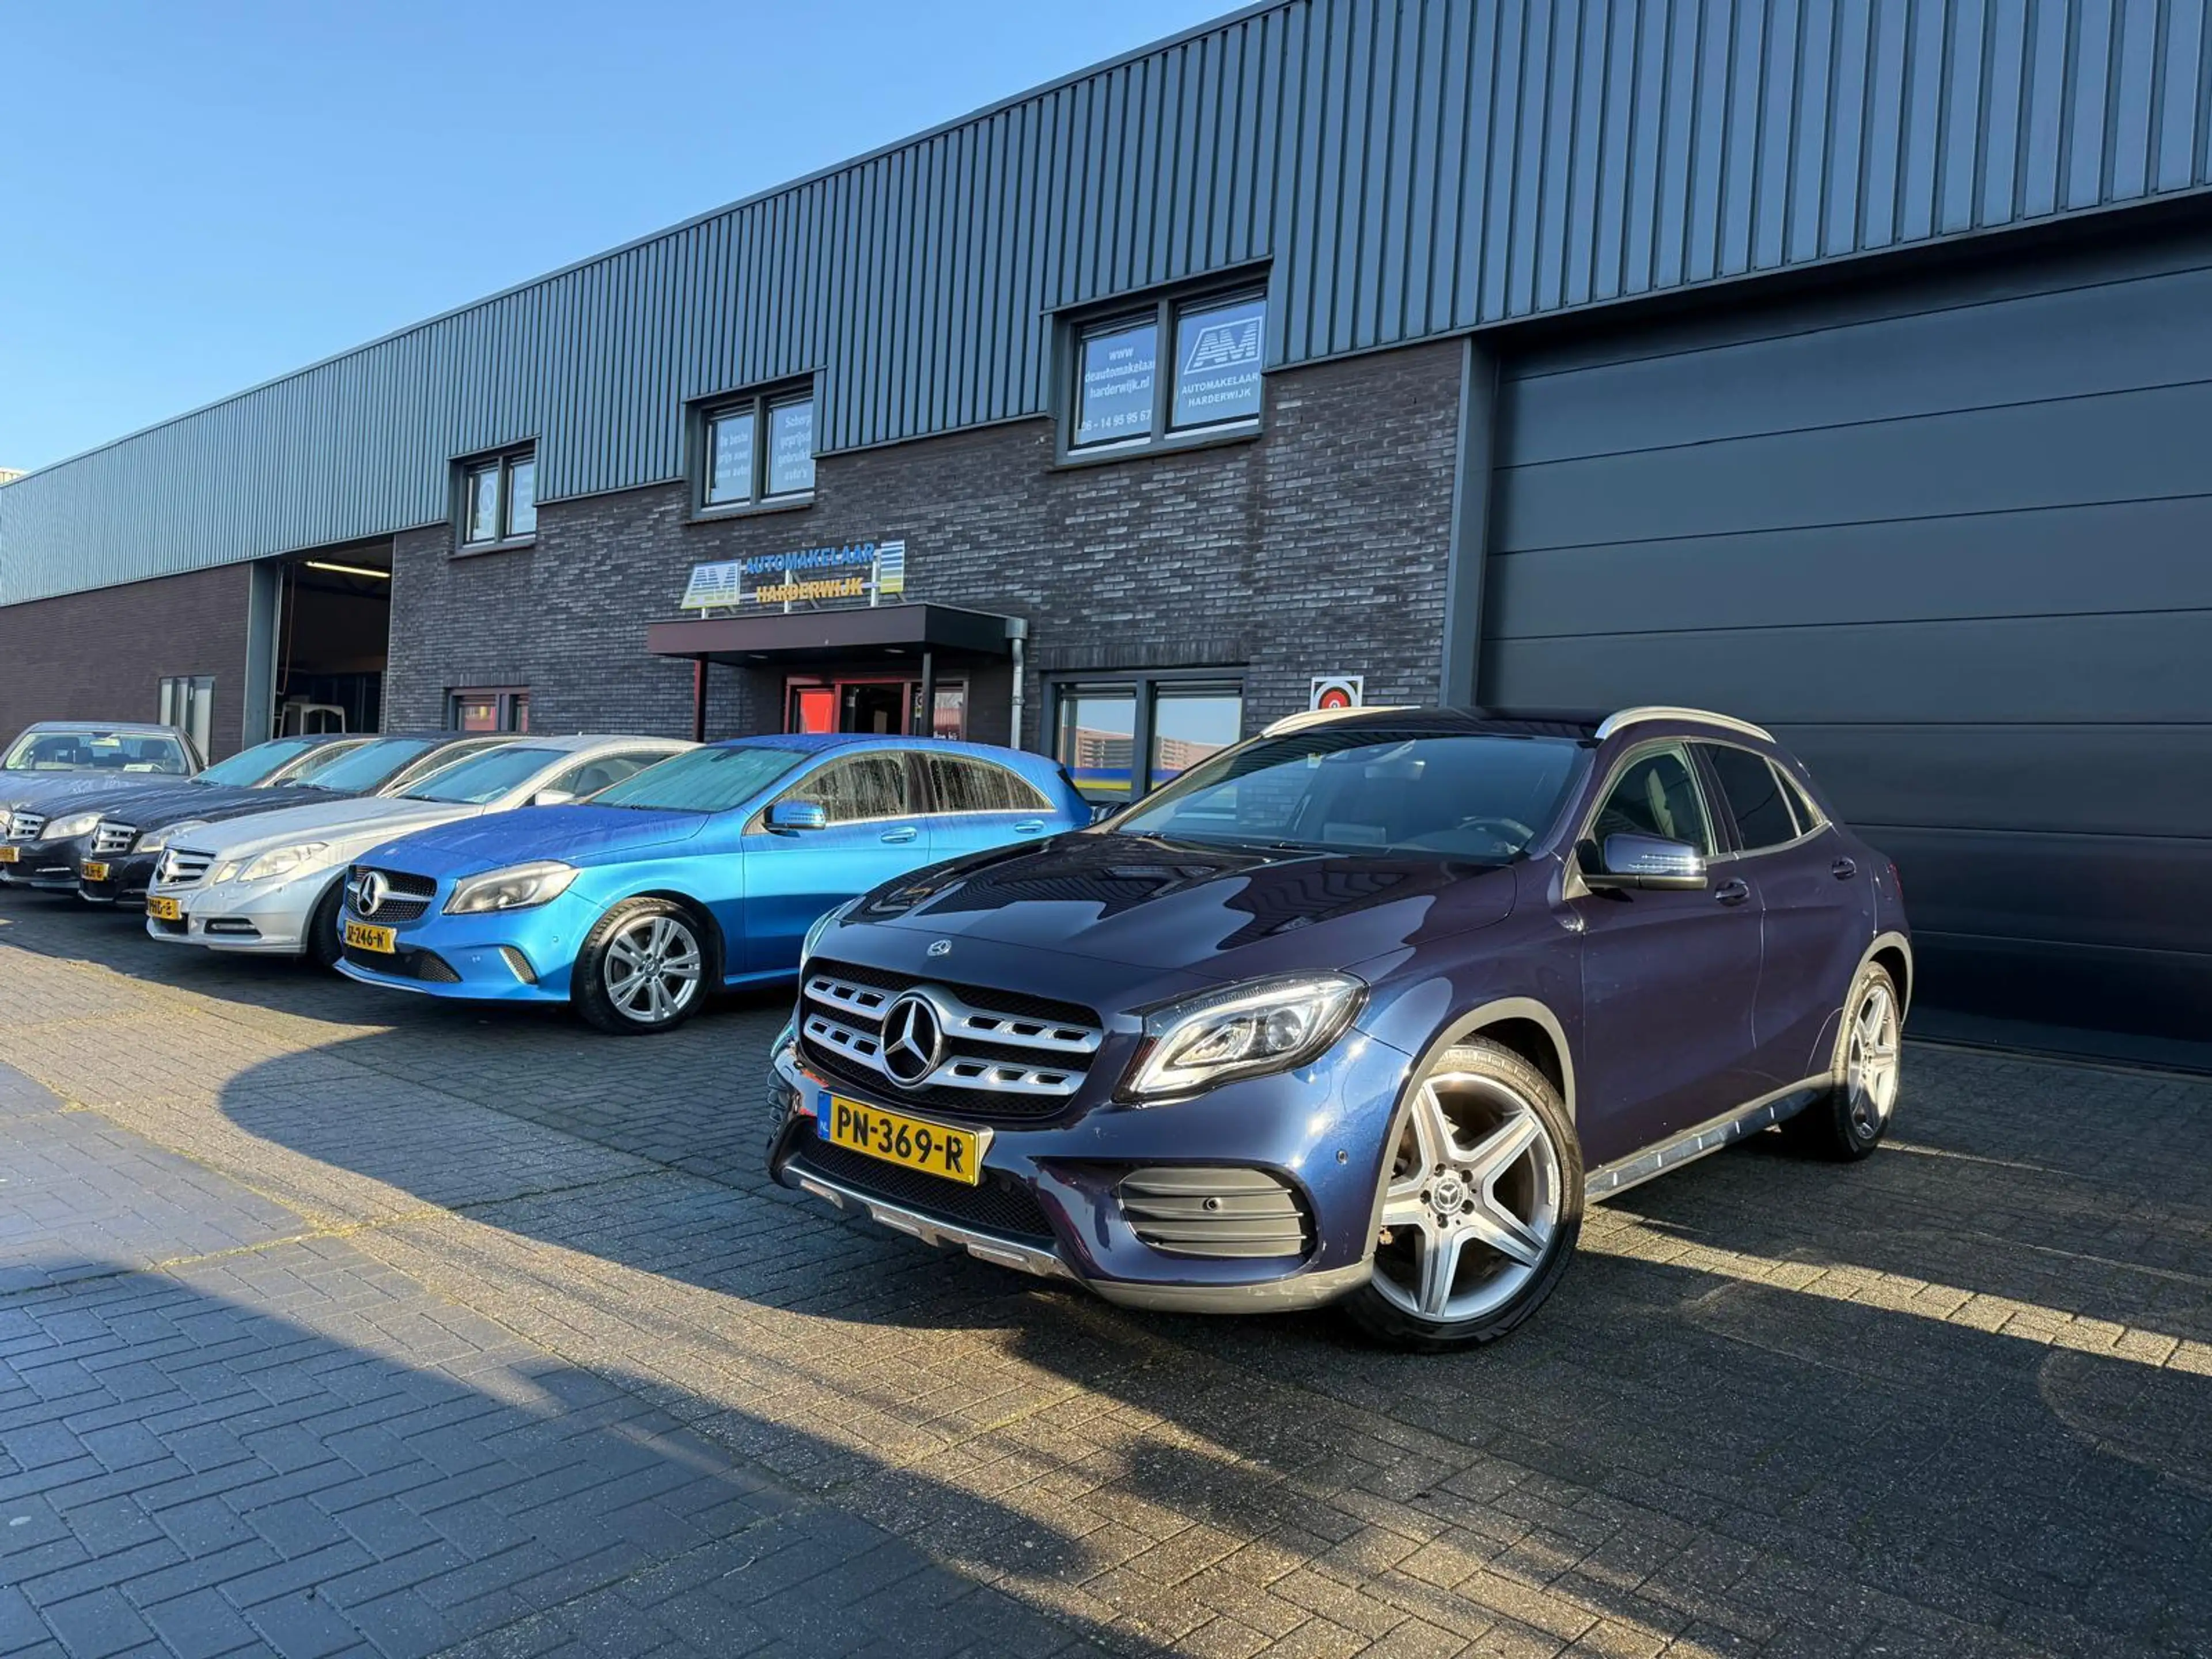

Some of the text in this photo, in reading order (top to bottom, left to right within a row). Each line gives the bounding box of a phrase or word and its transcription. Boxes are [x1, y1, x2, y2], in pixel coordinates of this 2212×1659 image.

[1089, 376, 1150, 399] harderwijk.nl
[1182, 372, 1259, 395] AUTOMAKELAAR
[1188, 387, 1252, 408] HARDERWIJK
[746, 543, 875, 574] AUTOMAKELAAR
[756, 578, 863, 603] HARDERWIJK
[838, 1104, 964, 1173] PN-369-R
